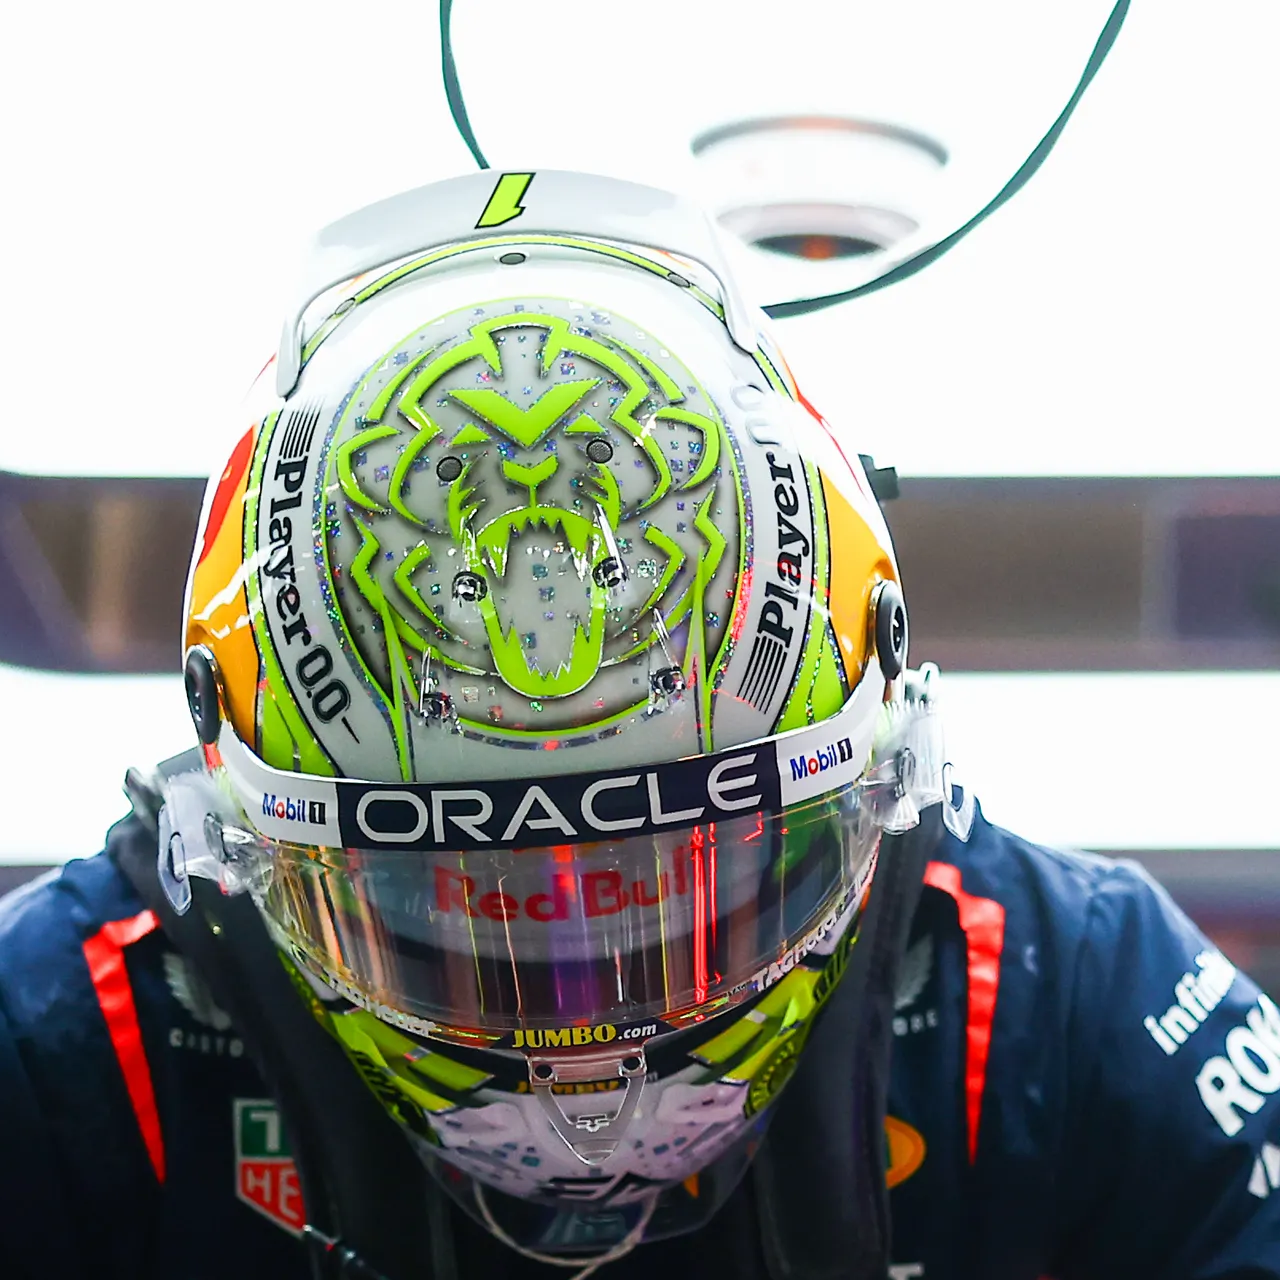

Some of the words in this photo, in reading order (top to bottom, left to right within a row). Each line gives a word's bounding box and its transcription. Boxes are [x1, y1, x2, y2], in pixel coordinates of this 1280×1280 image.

[475, 172, 536, 229] 1
[790, 745, 838, 782] Mobil
[839, 737, 853, 763] 1
[262, 792, 306, 823] Mobil
[309, 802, 326, 825] 1
[356, 753, 762, 842] ORACLE
[433, 866, 574, 921] Red
[581, 845, 698, 918] Bul
[511, 1021, 658, 1049] JUMBO.com
